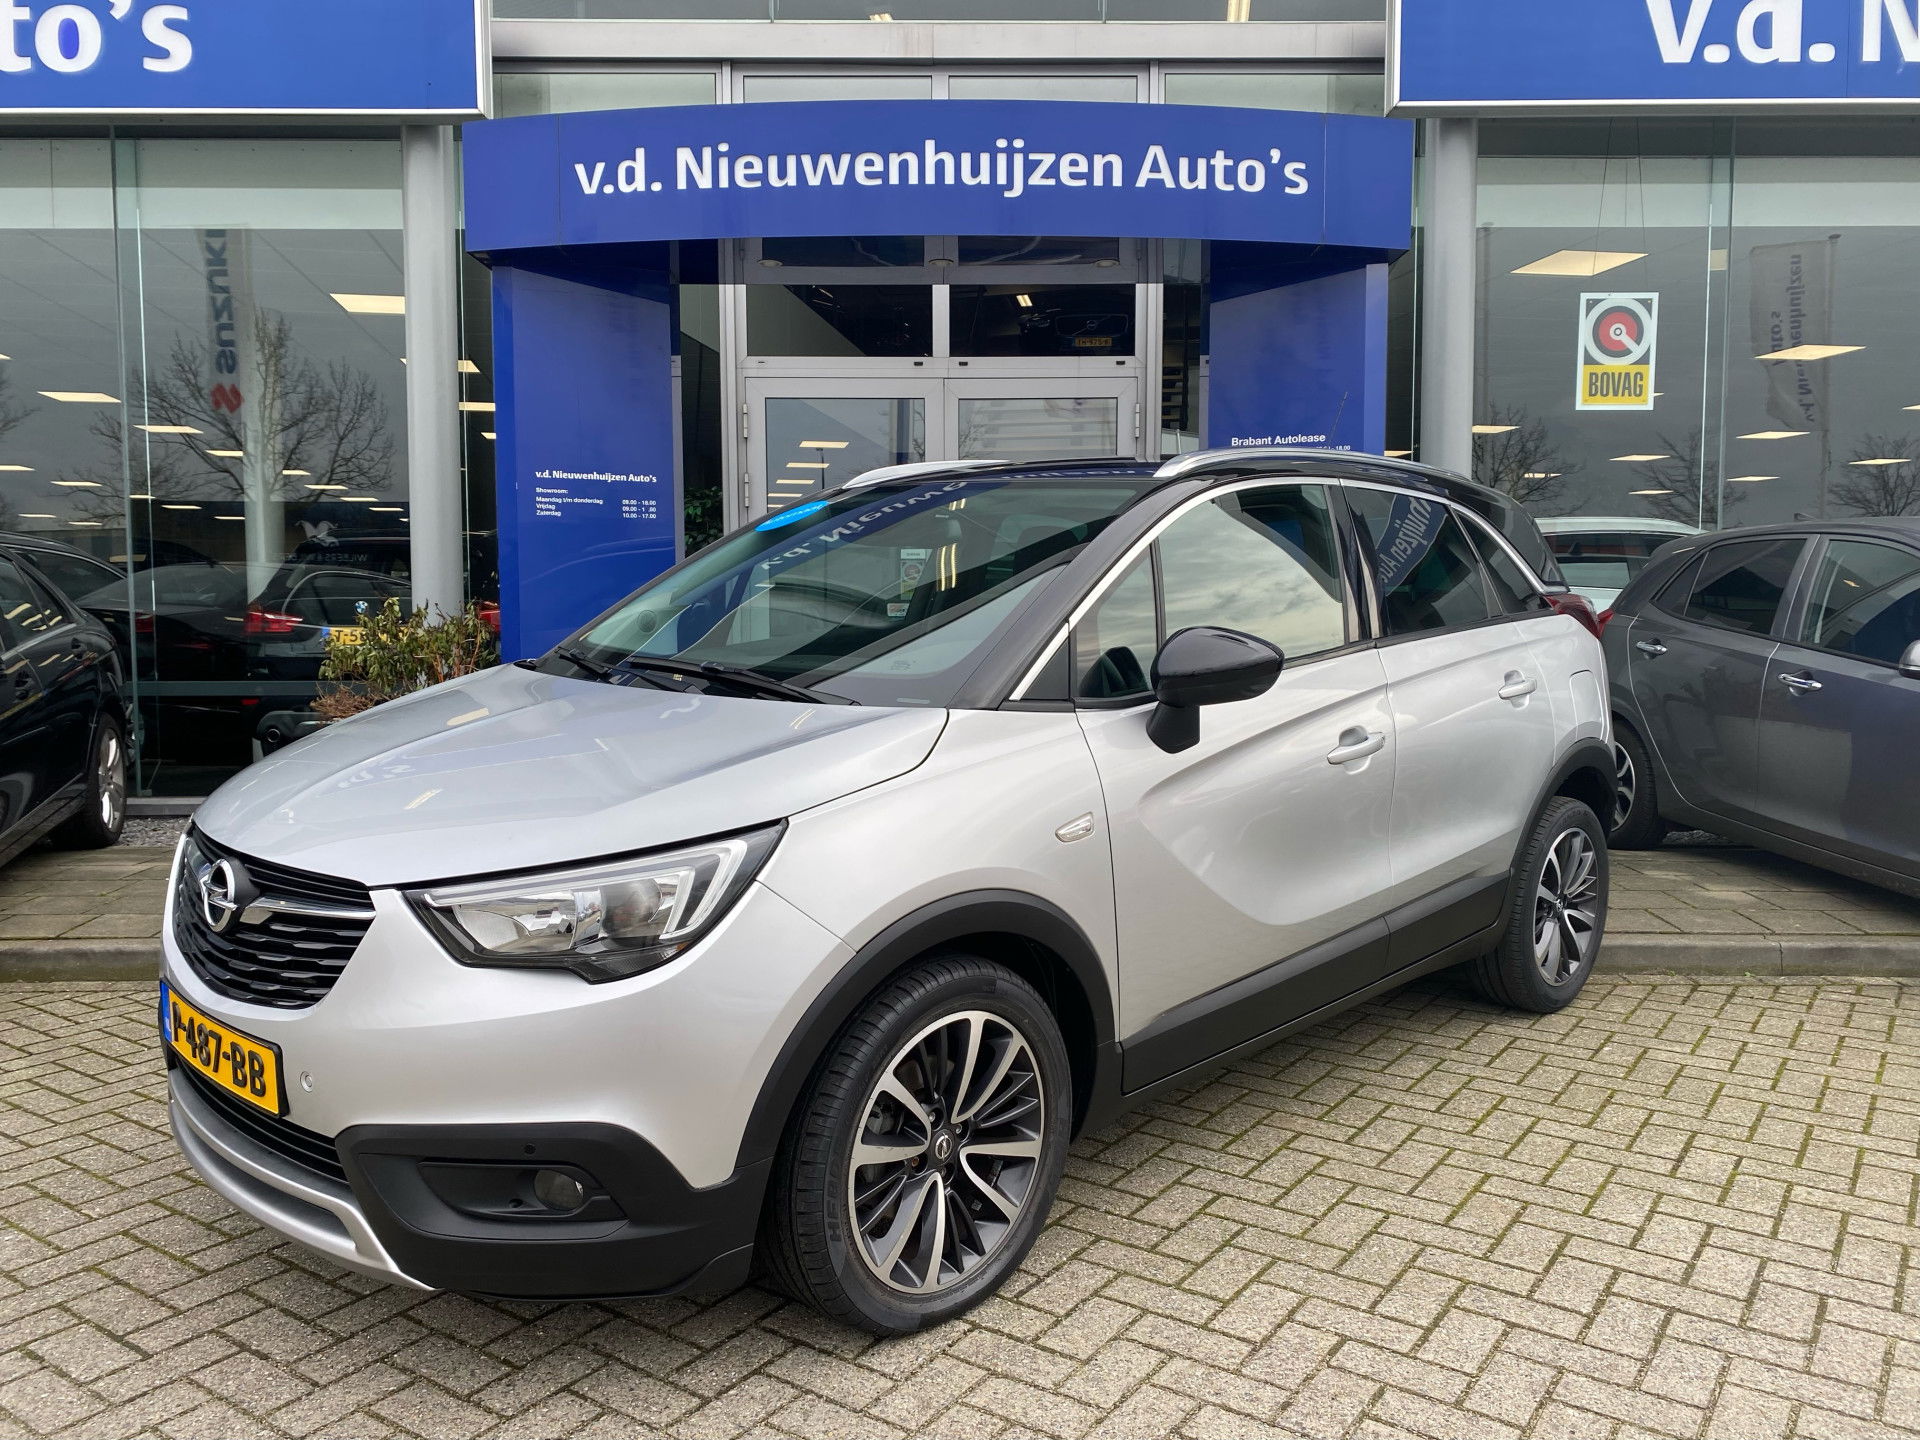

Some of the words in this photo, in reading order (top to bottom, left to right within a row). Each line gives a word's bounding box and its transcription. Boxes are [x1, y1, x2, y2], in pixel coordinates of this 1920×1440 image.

[574, 147, 663, 195] v.d.
[676, 138, 1123, 198] Nieuwenhuijzen
[1134, 145, 1309, 195] Auto's
[1588, 371, 1644, 398] BOVAG
[1231, 437, 1272, 447] Brabant
[1274, 433, 1326, 445] Autolease
[535, 470, 551, 479] v.d.
[552, 470, 627, 483] Nieuwenhuijzen
[628, 473, 657, 483] Auto's
[172, 1001, 266, 1098] P-487-BB
